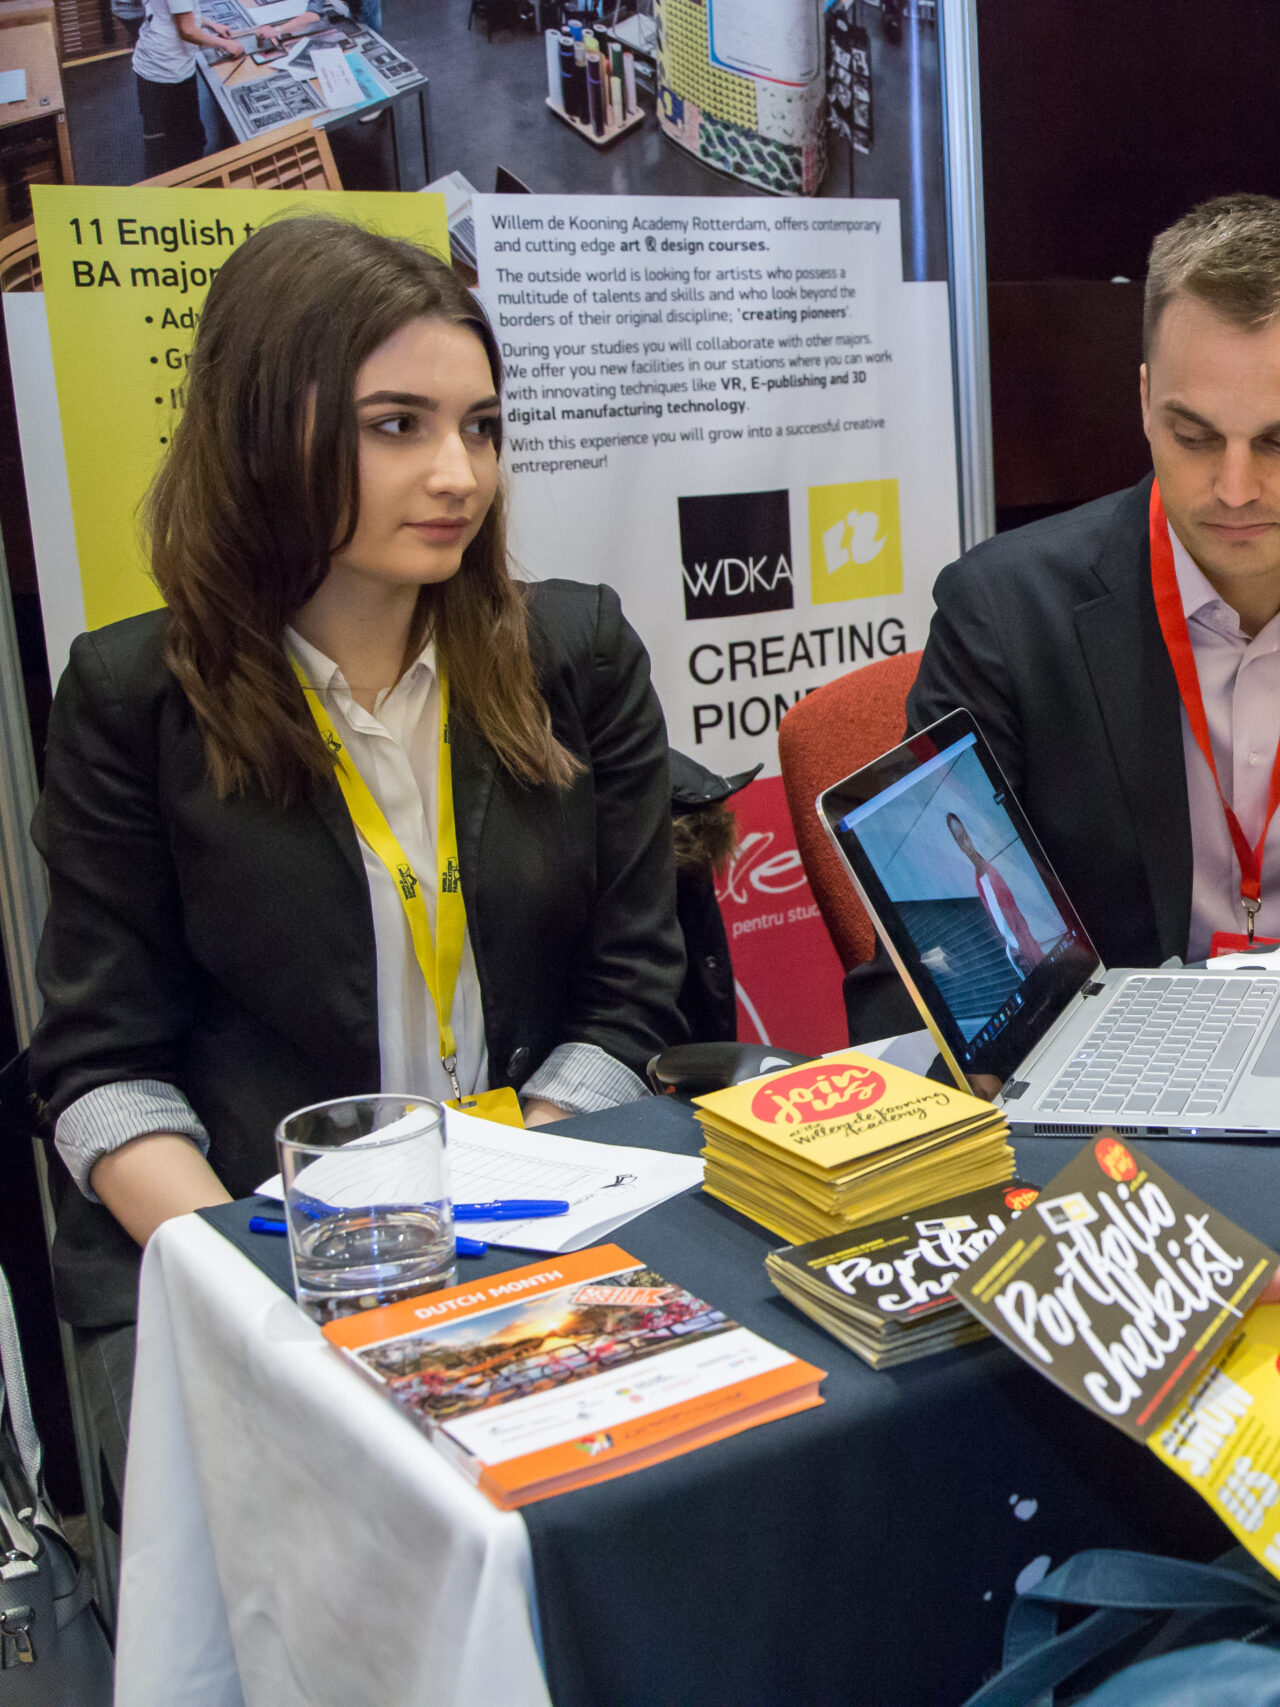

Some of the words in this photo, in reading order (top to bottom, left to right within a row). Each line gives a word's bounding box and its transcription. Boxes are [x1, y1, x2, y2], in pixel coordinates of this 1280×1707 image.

[69, 217, 103, 245] 11
[117, 217, 234, 254] English
[491, 215, 544, 230] Willem
[547, 216, 565, 230] de
[569, 216, 628, 234] Kooning
[632, 217, 689, 233] Academy
[692, 217, 771, 232] Rotterdam,
[774, 217, 809, 231] offers
[812, 218, 881, 234] contemporary
[494, 238, 521, 252] and
[525, 238, 576, 255] cutting
[581, 238, 615, 255] edge
[620, 239, 640, 252] art
[645, 236, 657, 252] &
[661, 239, 704, 254] design
[708, 240, 770, 251] courses.
[72, 260, 121, 288] BA
[130, 260, 219, 294] major
[496, 269, 523, 283] The
[528, 268, 581, 282] outside
[587, 268, 626, 282] world
[630, 268, 641, 281] is
[645, 267, 690, 284] looking
[694, 267, 711, 280] for
[716, 267, 763, 280] artists
[767, 267, 793, 279] who
[795, 268, 837, 282] possess
[839, 268, 846, 279] a
[498, 290, 569, 304] multitude
[573, 289, 588, 303] of
[592, 289, 641, 303] talents
[645, 288, 668, 302] and
[671, 287, 705, 301] skills
[709, 287, 735, 301] and
[739, 288, 768, 300] who
[772, 286, 797, 300] look
[800, 286, 838, 302] beyond
[840, 286, 856, 298] the
[499, 312, 555, 327] borders
[559, 312, 575, 325] of
[578, 311, 612, 325] their
[615, 309, 663, 327] original
[666, 308, 733, 325] discipline;
[502, 343, 550, 359] During
[553, 343, 586, 359] your
[591, 340, 639, 354] studies
[642, 341, 666, 356] you
[669, 338, 692, 351] will
[696, 336, 774, 351] collaborate
[778, 335, 803, 349] with
[805, 334, 833, 347] other
[835, 333, 873, 348] majors.
[504, 364, 527, 379] We
[531, 363, 565, 378] offer
[570, 364, 597, 380] you
[600, 362, 628, 375] new
[631, 359, 685, 374] facilities
[688, 359, 700, 371] in
[704, 359, 727, 371] our
[731, 356, 785, 370] stations
[788, 354, 821, 367] where
[824, 354, 842, 368] you
[844, 353, 862, 365] can
[865, 350, 893, 364] work
[505, 386, 538, 401] with
[541, 383, 617, 400] innovating
[620, 381, 688, 397] techniques
[692, 378, 716, 392] like
[720, 376, 747, 392] VR,
[751, 372, 827, 392] E-publishing
[830, 371, 849, 385] and
[852, 370, 867, 383] 3D
[508, 407, 556, 425] digital
[561, 403, 663, 420] manufacturing
[667, 398, 750, 414] technology.
[509, 438, 544, 452] With
[548, 436, 576, 450] this
[580, 433, 648, 450] experience
[652, 431, 676, 446] you
[680, 427, 704, 441] will
[708, 426, 743, 444] grow
[747, 425, 773, 438] into
[776, 426, 783, 437] a
[786, 419, 840, 435] successful
[843, 417, 885, 431] creative
[511, 455, 608, 475] entrepreneur!
[682, 554, 793, 597] WDKA
[688, 617, 906, 685] CREATING
[692, 687, 820, 744] PION
[732, 912, 784, 939] pentru
[764, 1068, 873, 1125] join
[811, 1080, 877, 1111] us
[826, 1214, 1006, 1296] Portfo
[995, 1182, 1177, 1363] Portfolio
[414, 1292, 486, 1320] DUTCH
[491, 1270, 563, 1299] MONTH
[1078, 1213, 1244, 1415] checklist
[1161, 1366, 1254, 1477] SHOW
